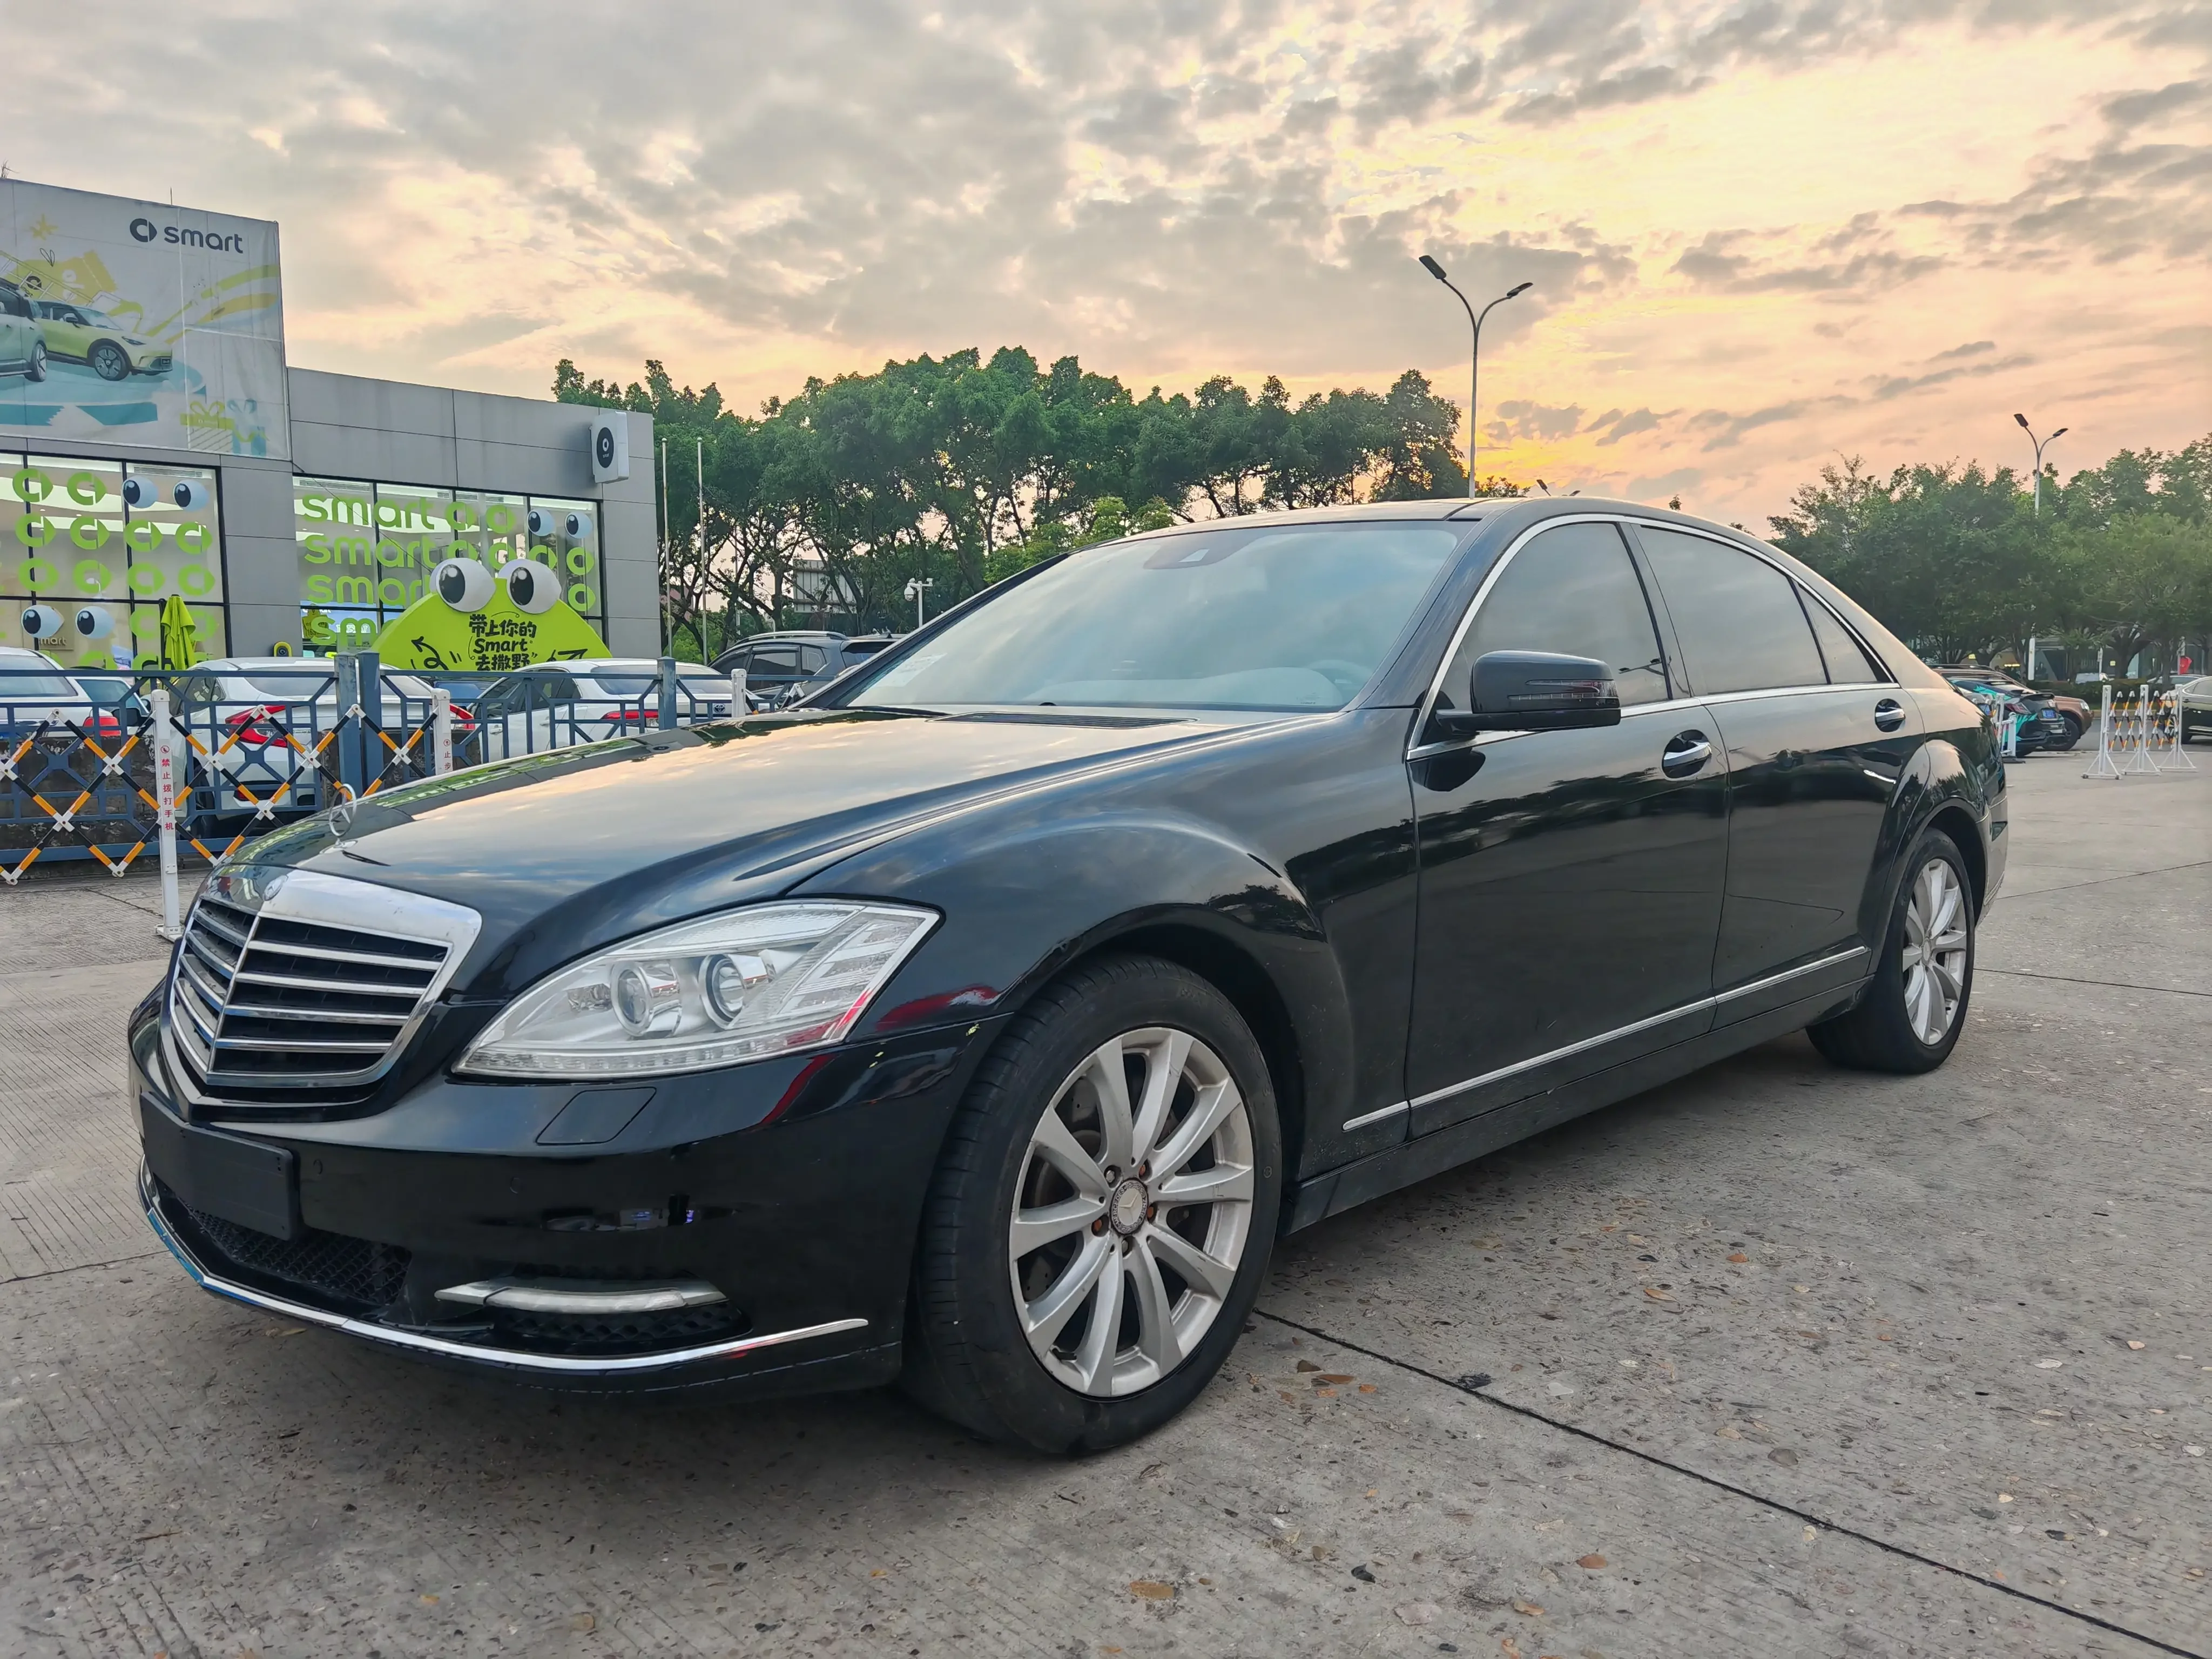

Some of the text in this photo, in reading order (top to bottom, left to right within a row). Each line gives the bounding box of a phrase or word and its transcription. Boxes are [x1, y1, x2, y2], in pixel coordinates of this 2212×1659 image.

[164, 226, 243, 254] smart
[302, 494, 435, 530] smart
[305, 533, 437, 569] smart
[39, 637, 67, 645] mart
[469, 613, 537, 638] 带上你的
[473, 638, 528, 654] Smart
[161, 758, 174, 831] 禁止拨打手机
[1112, 1187, 1125, 1226] MERCEDES
